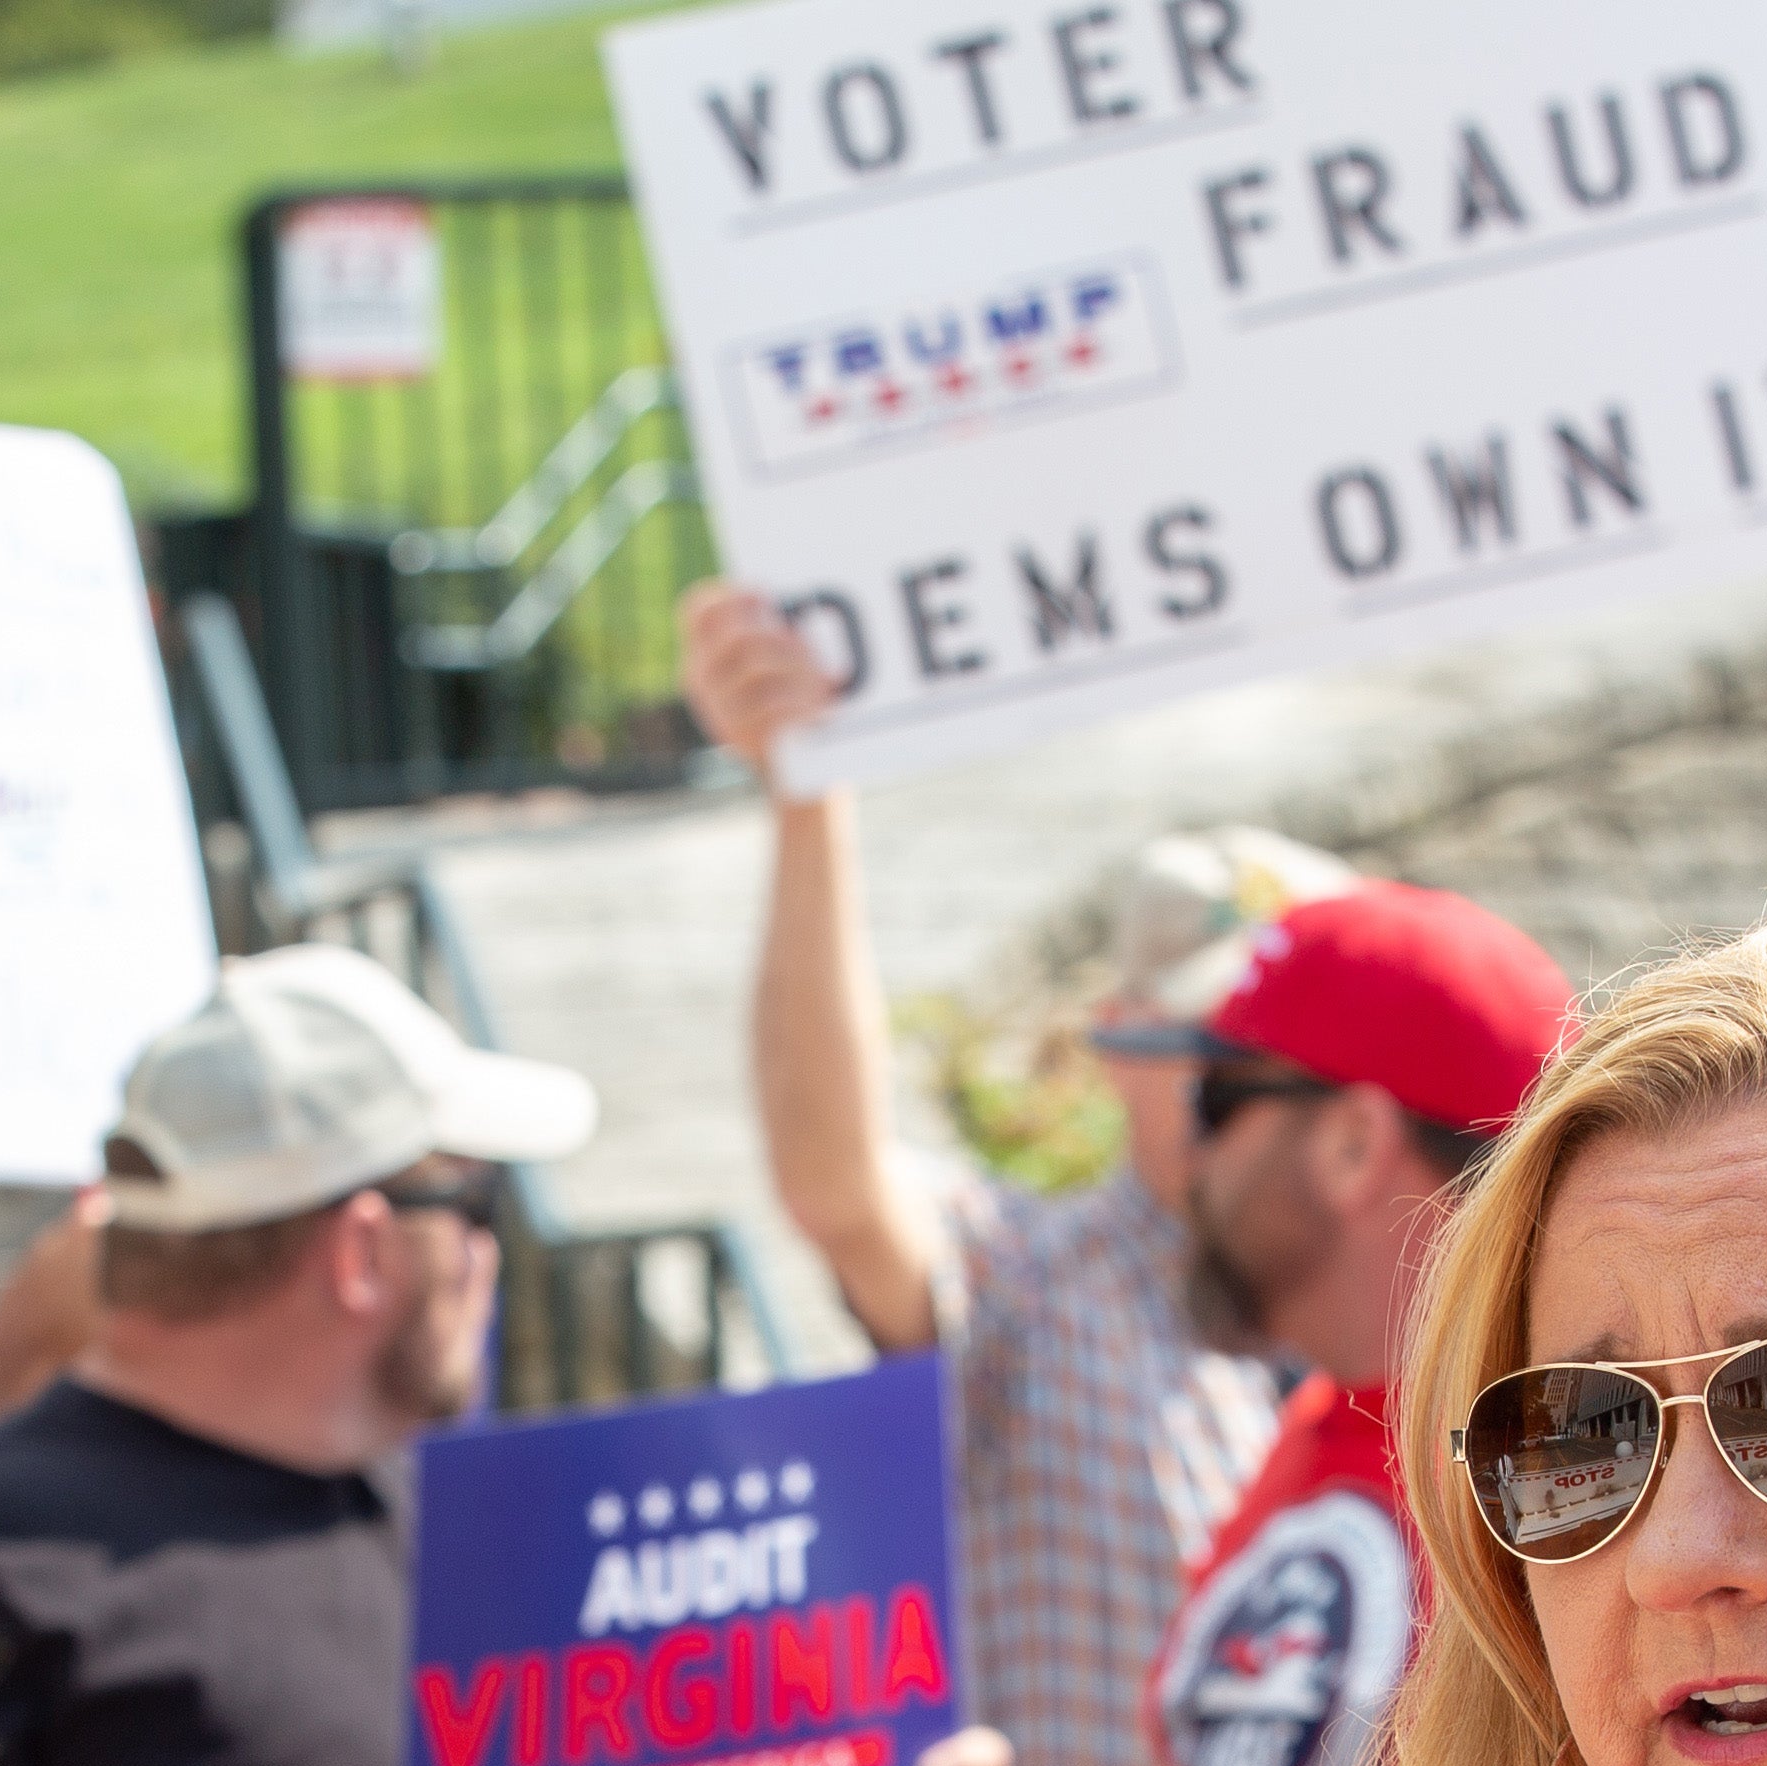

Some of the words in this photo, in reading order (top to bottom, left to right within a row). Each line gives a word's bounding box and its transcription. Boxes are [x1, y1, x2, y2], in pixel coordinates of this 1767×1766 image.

[704, 0, 1264, 194] VOTER
[1198, 70, 1756, 296] FRAUD
[762, 274, 1122, 393] TRUMP
[779, 500, 1236, 703] DEMS
[1315, 402, 1644, 582] OWN
[579, 1512, 818, 1637] AUDIT
